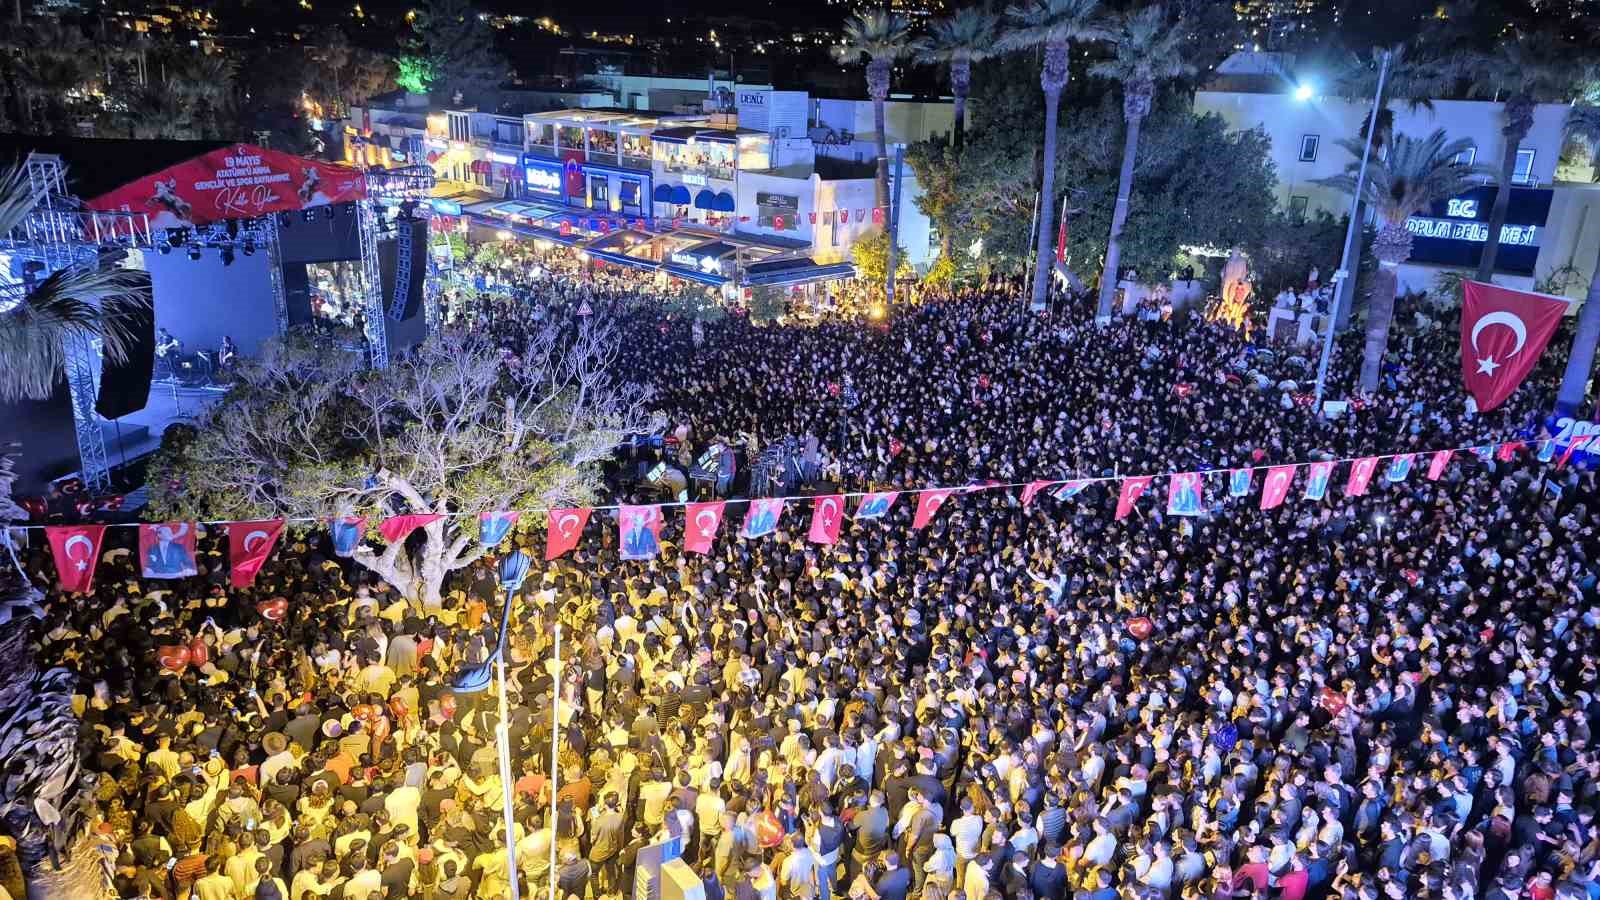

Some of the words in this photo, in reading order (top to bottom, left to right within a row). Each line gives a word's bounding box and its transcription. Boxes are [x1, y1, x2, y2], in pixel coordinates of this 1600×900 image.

[224, 156, 235, 167] 19
[235, 155, 261, 166] MAYIS
[1448, 199, 1477, 218] T.C.
[1406, 218, 1452, 239] DRUM
[1452, 221, 1537, 246] BELEİYESİ
